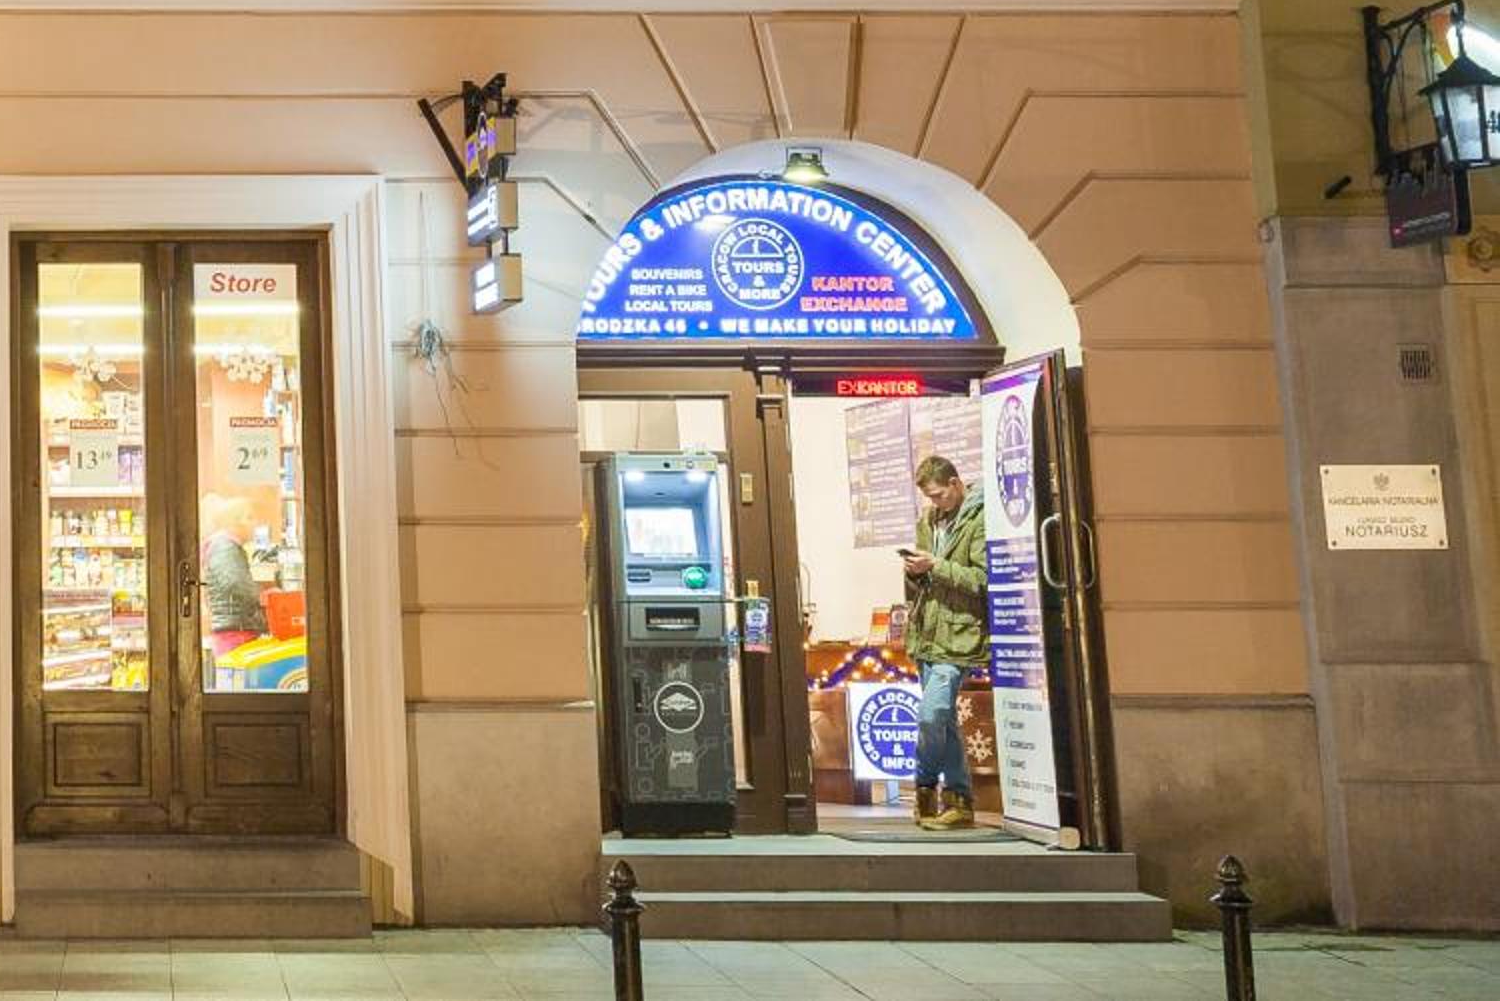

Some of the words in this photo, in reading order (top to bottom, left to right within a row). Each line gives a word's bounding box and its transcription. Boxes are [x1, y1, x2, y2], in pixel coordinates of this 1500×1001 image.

[640, 218, 664, 241] &
[661, 187, 853, 231] INFORMATION
[855, 221, 946, 315] CENTER
[717, 232, 739, 293] CRACOW
[737, 224, 784, 245] LOCAL
[631, 269, 703, 280] SOUVENIRS
[731, 262, 785, 273] TOURS
[211, 272, 277, 293] Store
[629, 284, 663, 295] RENT
[665, 284, 675, 295] A
[677, 284, 707, 295] BIKE
[811, 277, 894, 292] KANTOR
[740, 289, 782, 299] MORE
[624, 300, 669, 312] LOCAL
[669, 300, 713, 312] TOURS
[801, 297, 908, 312] EXCHANGE
[577, 318, 661, 334] RODZKA
[663, 318, 687, 334] 46
[720, 319, 749, 334] WE
[755, 319, 809, 334] MAKE
[813, 319, 867, 334] YOUR
[871, 319, 956, 334] HOLIDAY
[1345, 524, 1428, 537] NOTARIUSZ
[861, 700, 882, 762] CRACOW
